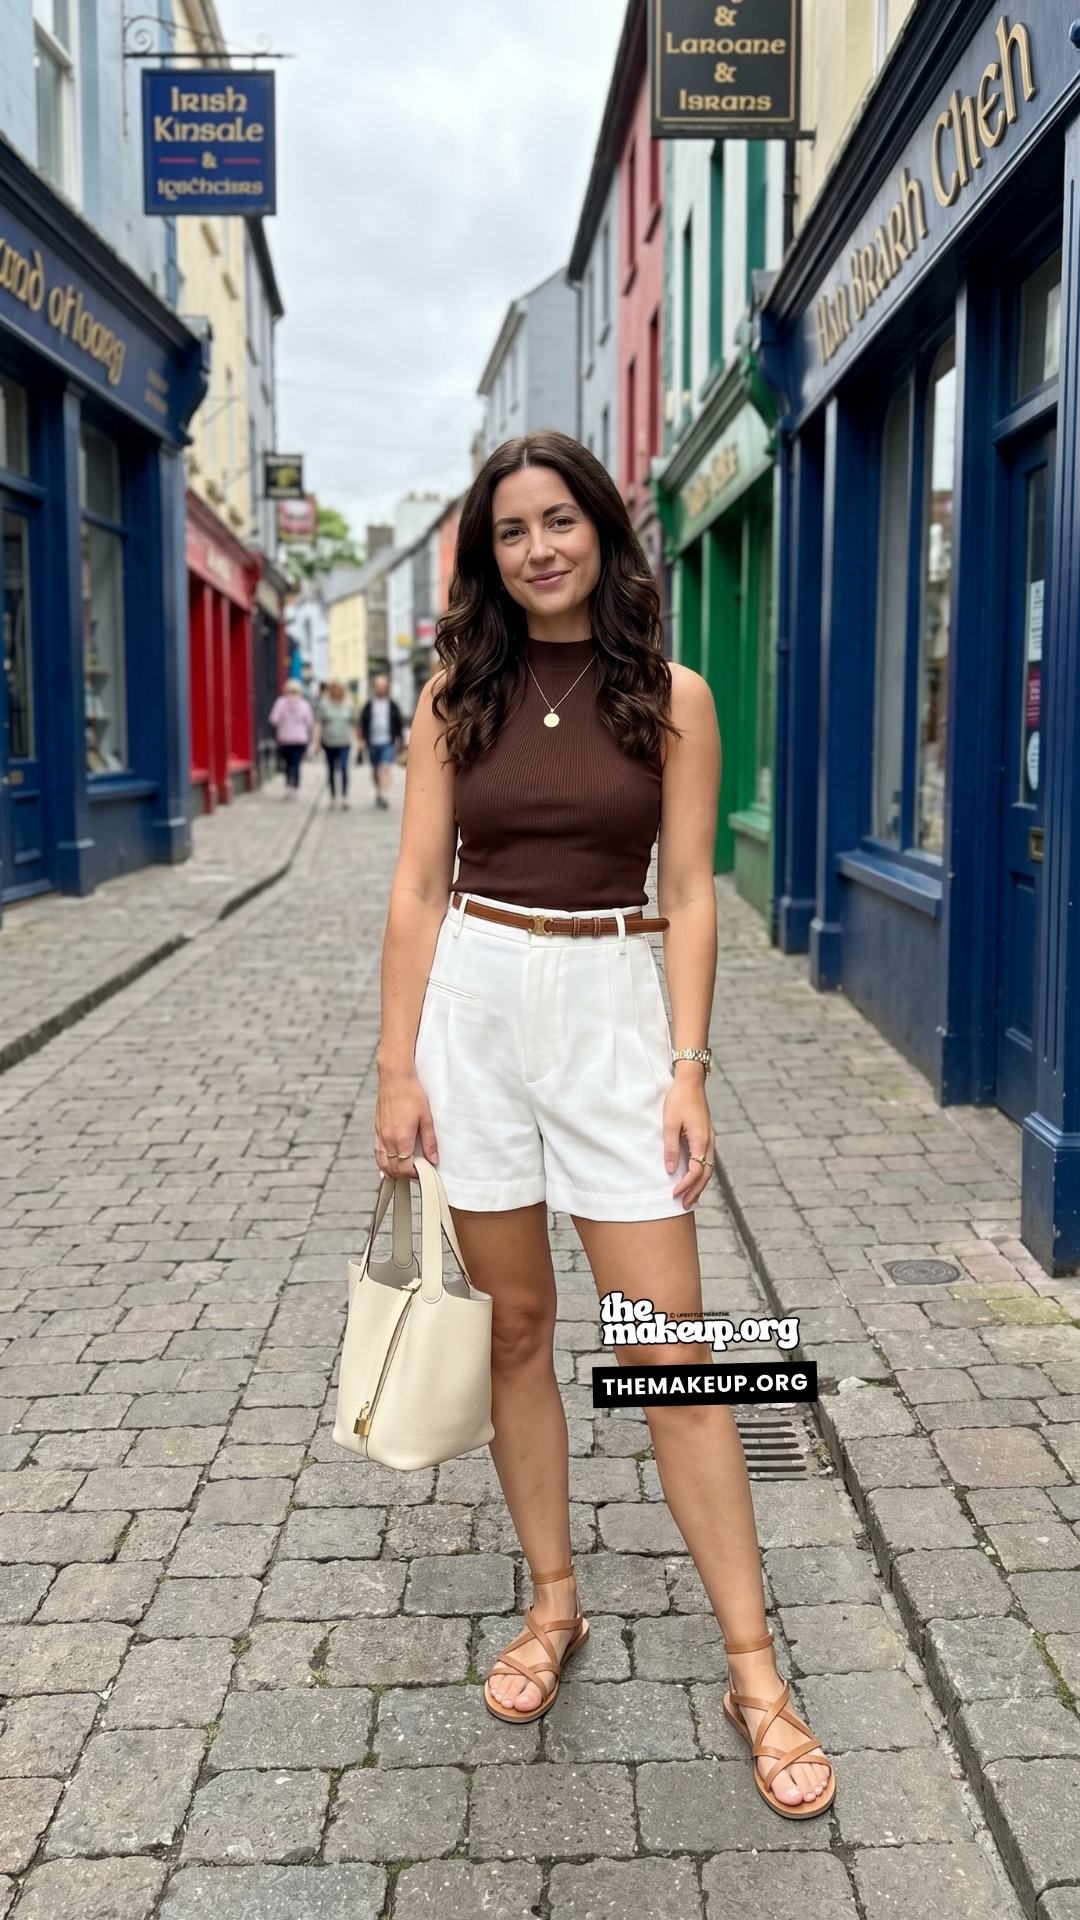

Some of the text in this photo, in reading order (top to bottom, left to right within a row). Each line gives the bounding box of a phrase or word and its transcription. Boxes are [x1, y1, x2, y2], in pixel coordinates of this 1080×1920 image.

[714, 5, 737, 26] &
[714, 62, 737, 83] &
[171, 86, 248, 113] Irish
[153, 115, 264, 142] Kinsale
[201, 151, 217, 169] &
